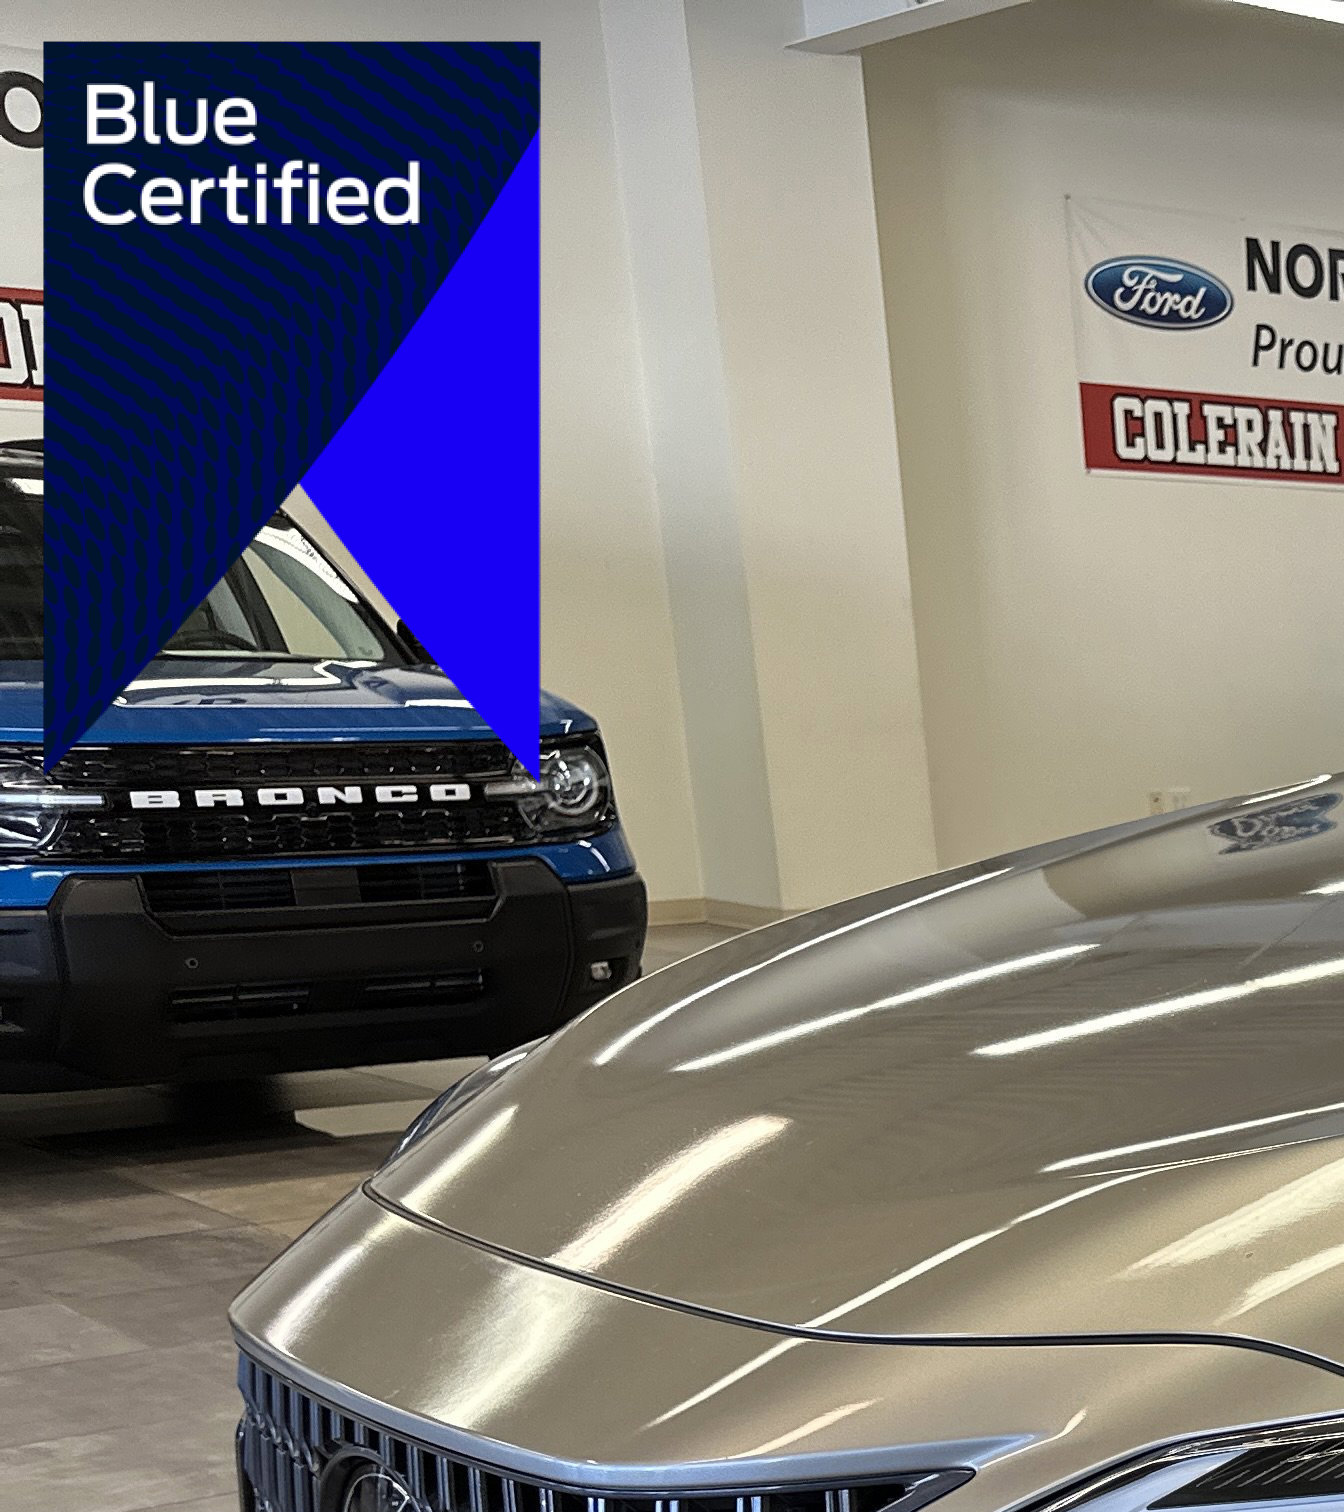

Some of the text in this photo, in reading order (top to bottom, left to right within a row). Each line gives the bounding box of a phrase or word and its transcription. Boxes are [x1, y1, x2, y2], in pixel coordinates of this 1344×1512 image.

[1113, 265, 1206, 321] Ford
[1112, 395, 1340, 476] COLERAIN
[131, 783, 472, 810] BRONCO
